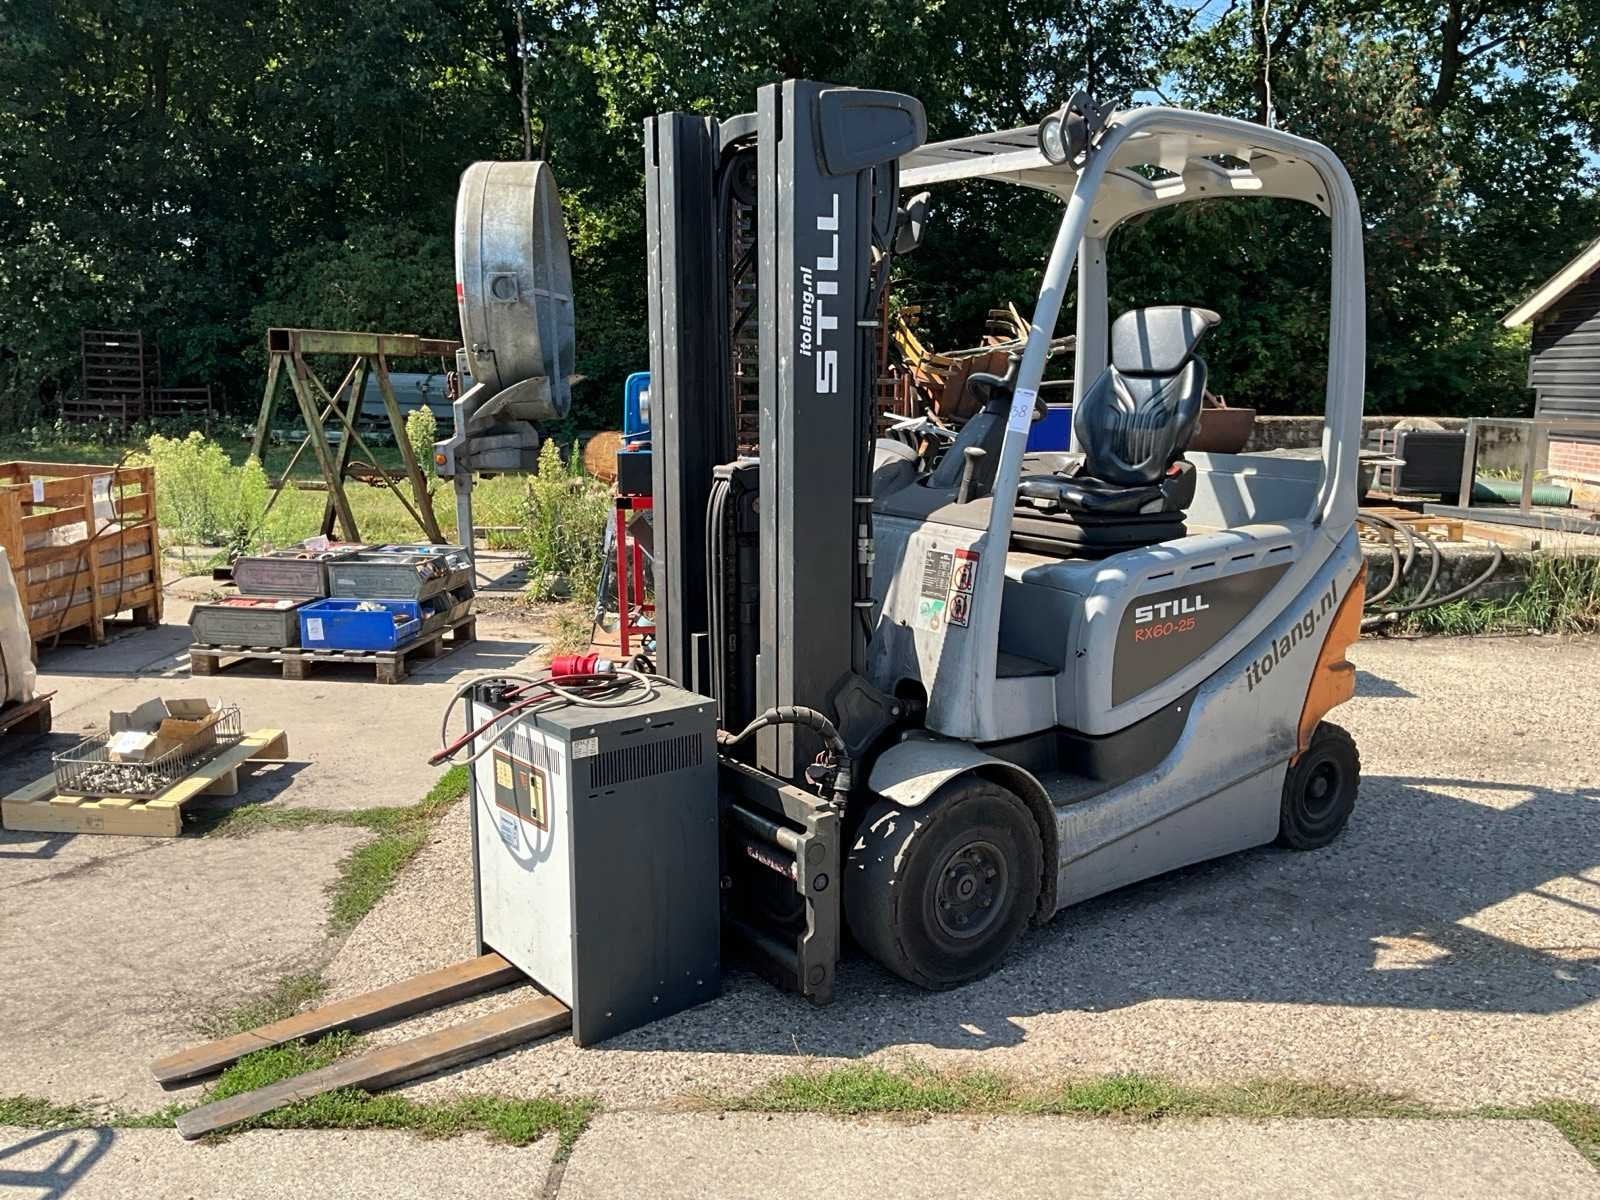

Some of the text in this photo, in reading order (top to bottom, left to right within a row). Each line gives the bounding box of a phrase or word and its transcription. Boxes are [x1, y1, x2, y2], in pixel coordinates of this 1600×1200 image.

[799, 266, 815, 356] itolang.nl
[816, 193, 839, 393] STILL
[1135, 595, 1209, 624] STILL
[1135, 616, 1197, 642] RX60-25
[1245, 579, 1338, 693] itolang.nl
